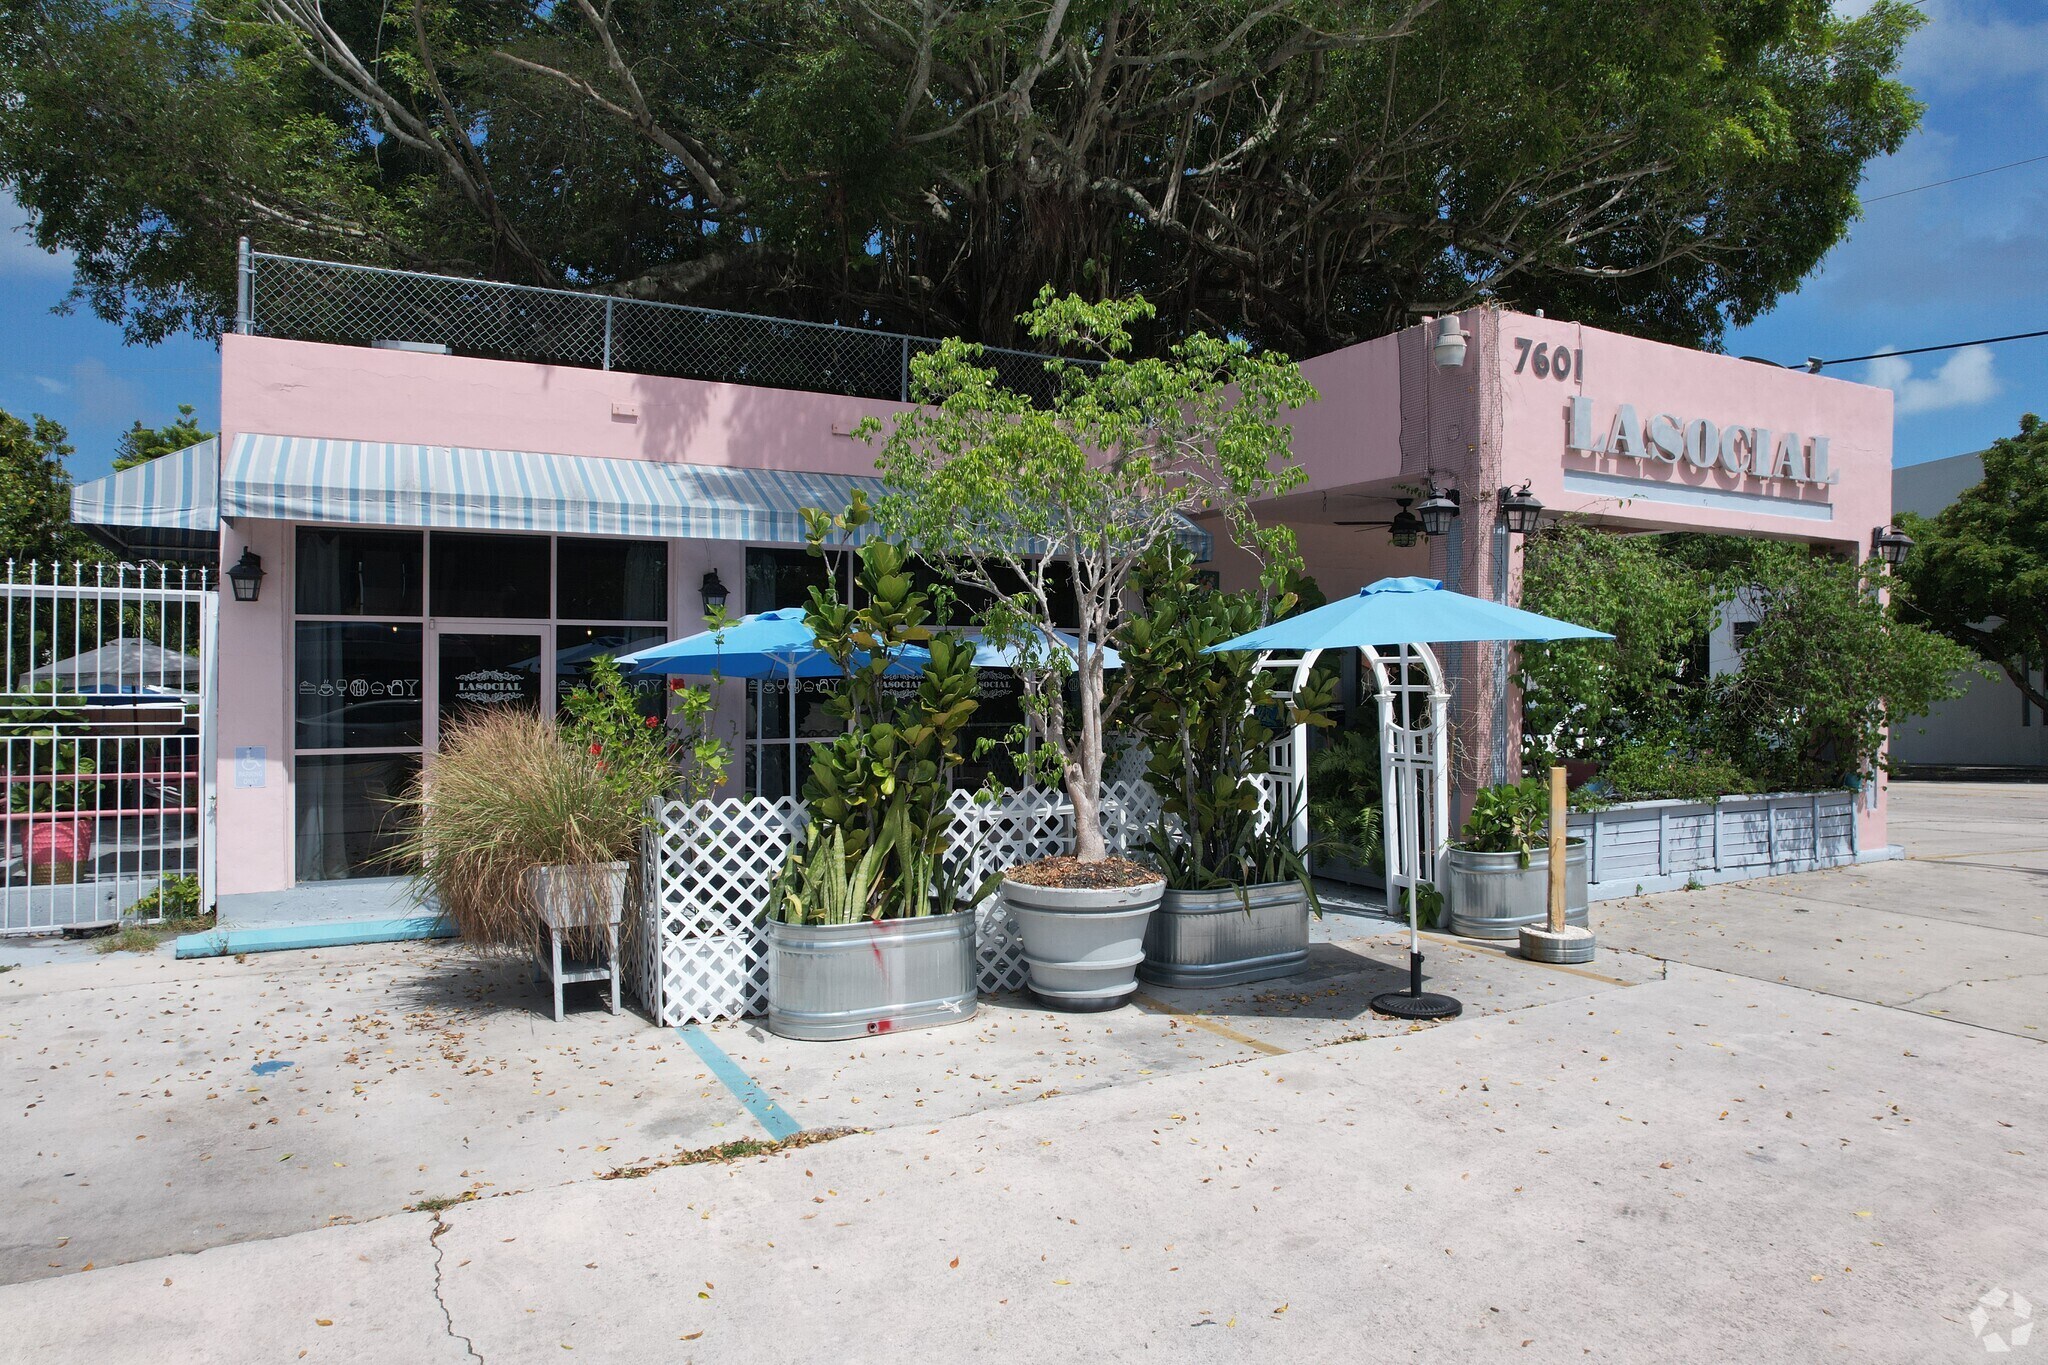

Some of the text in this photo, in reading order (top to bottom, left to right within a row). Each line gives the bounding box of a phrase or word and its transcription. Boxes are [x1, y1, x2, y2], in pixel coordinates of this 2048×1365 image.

[1514, 337, 1583, 384] 7601
[1566, 395, 1840, 485] LASOCIAL
[459, 682, 521, 691] LASOCIAL
